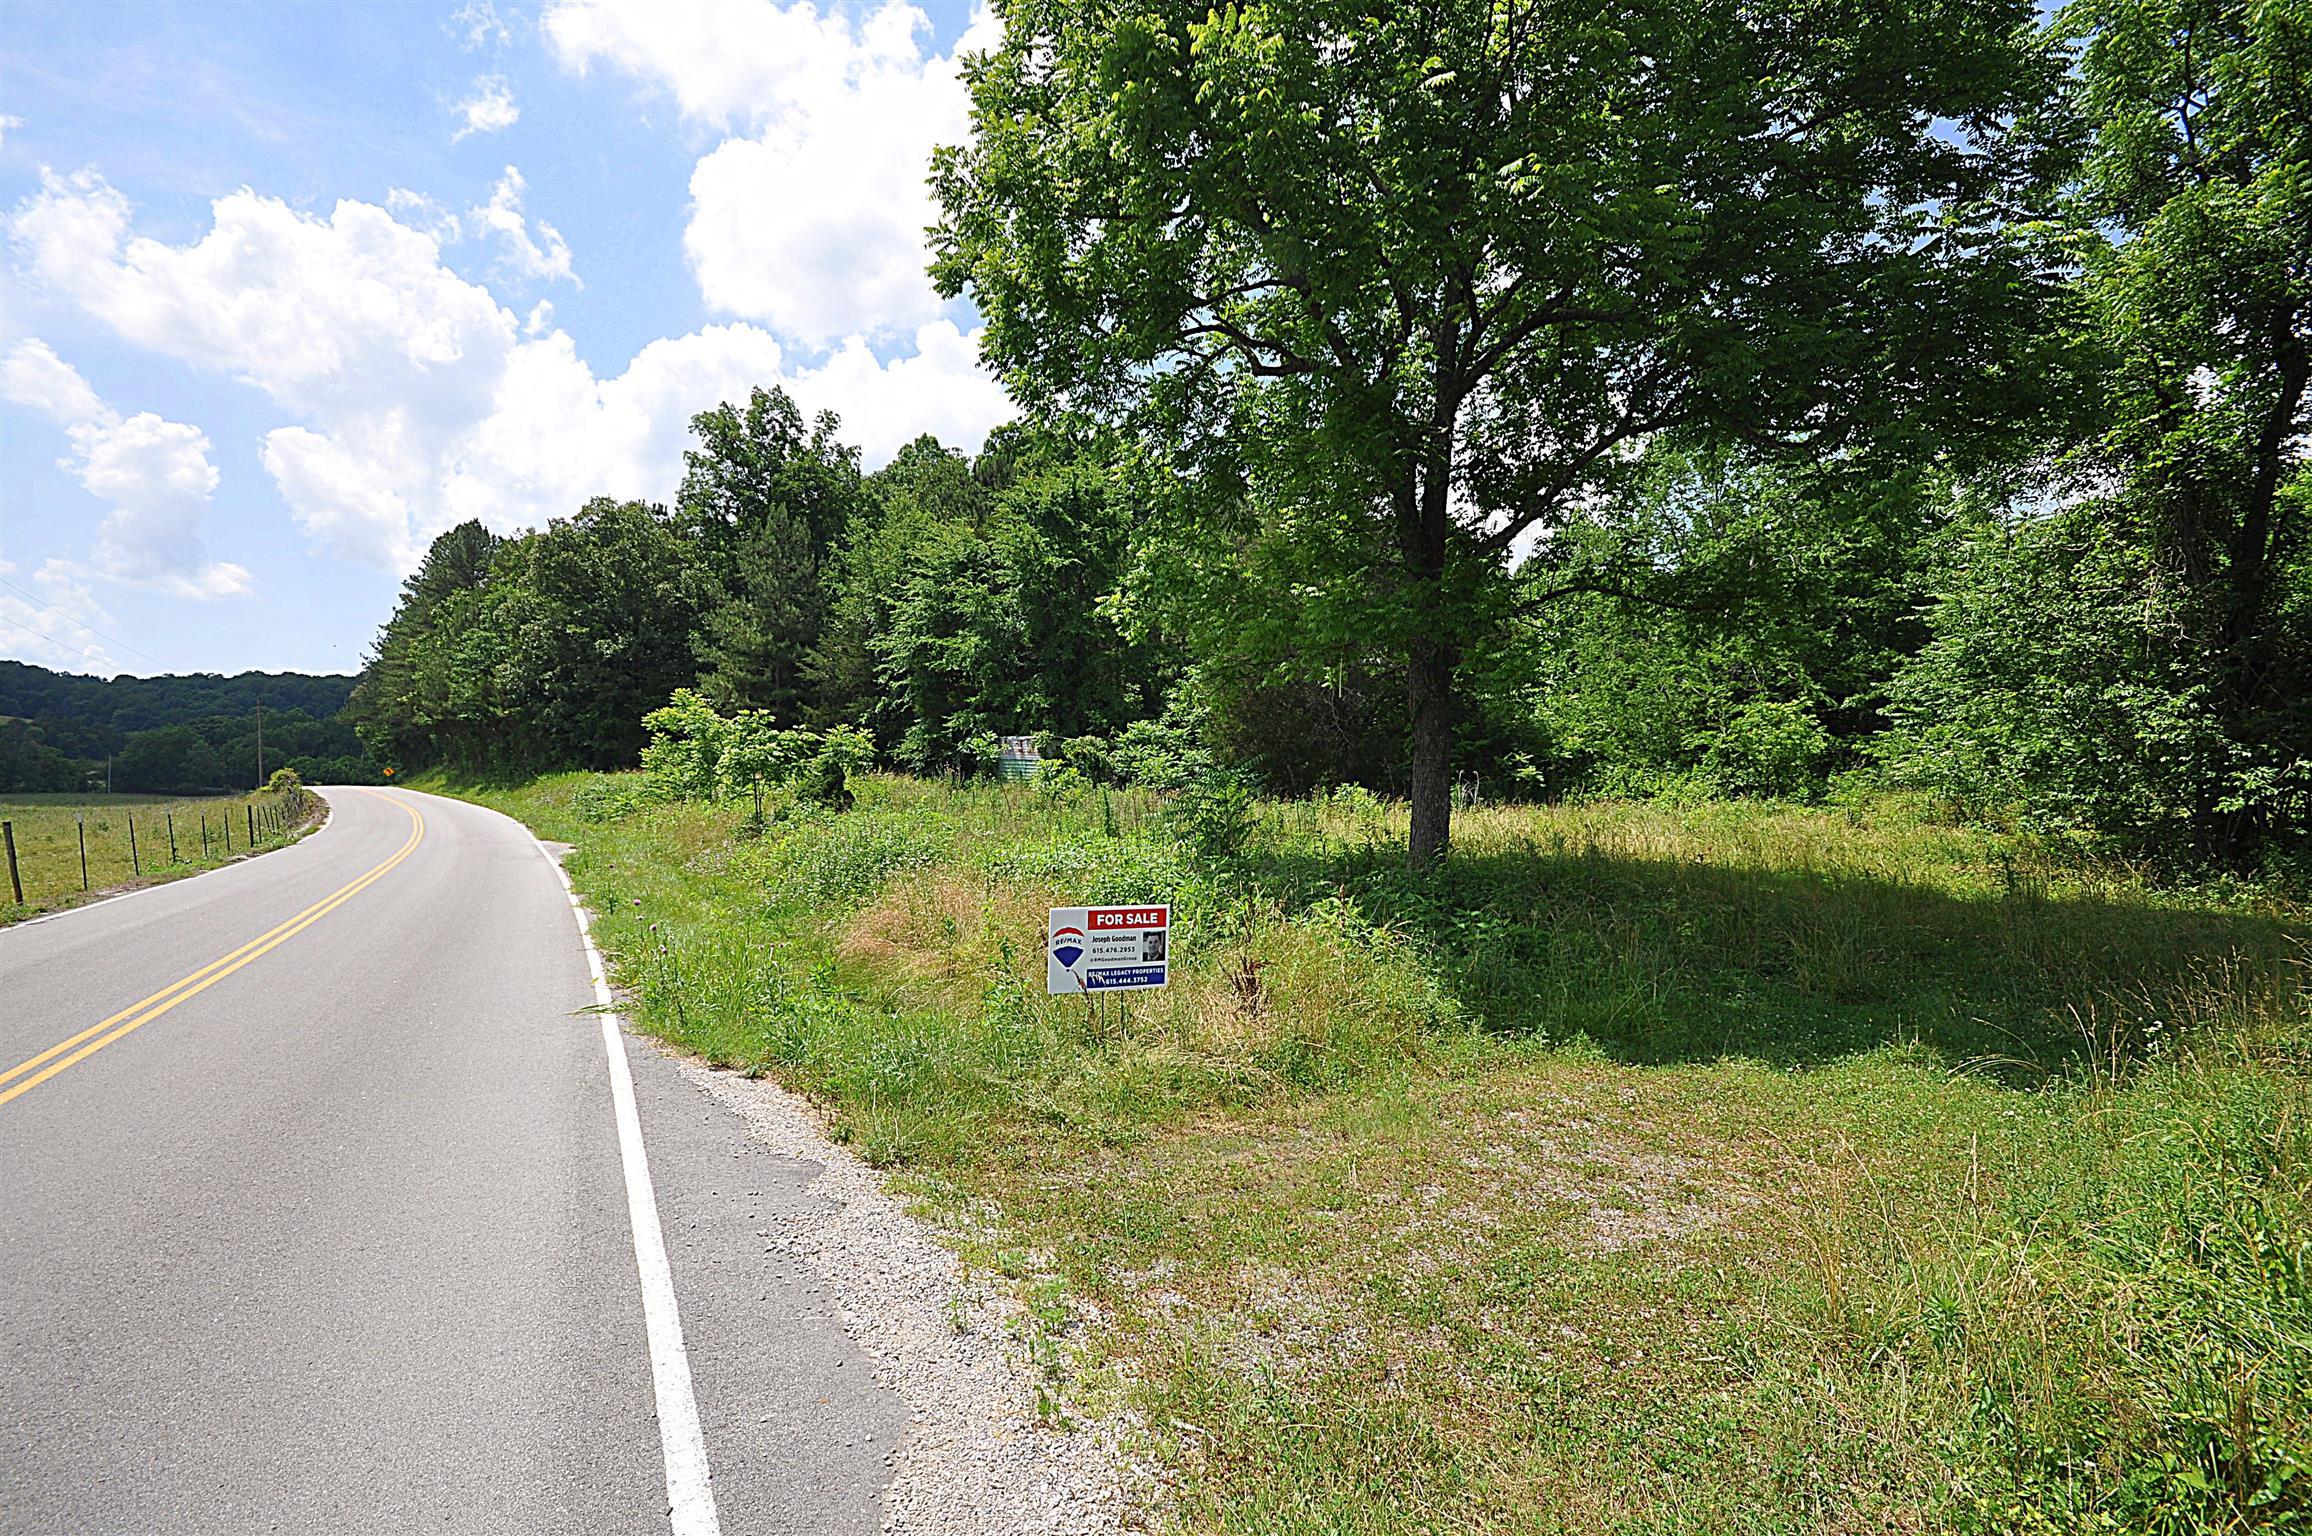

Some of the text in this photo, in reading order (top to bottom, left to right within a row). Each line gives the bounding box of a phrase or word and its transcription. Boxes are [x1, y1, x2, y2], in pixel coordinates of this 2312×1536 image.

[1097, 913, 1158, 926] FOR SALE
[1055, 937, 1082, 946] RE/MAX
[1092, 946, 1135, 954] 615.476.2953
[1132, 967, 1164, 975] PROPERTIES
[1105, 976, 1148, 985] 615.444.3752
